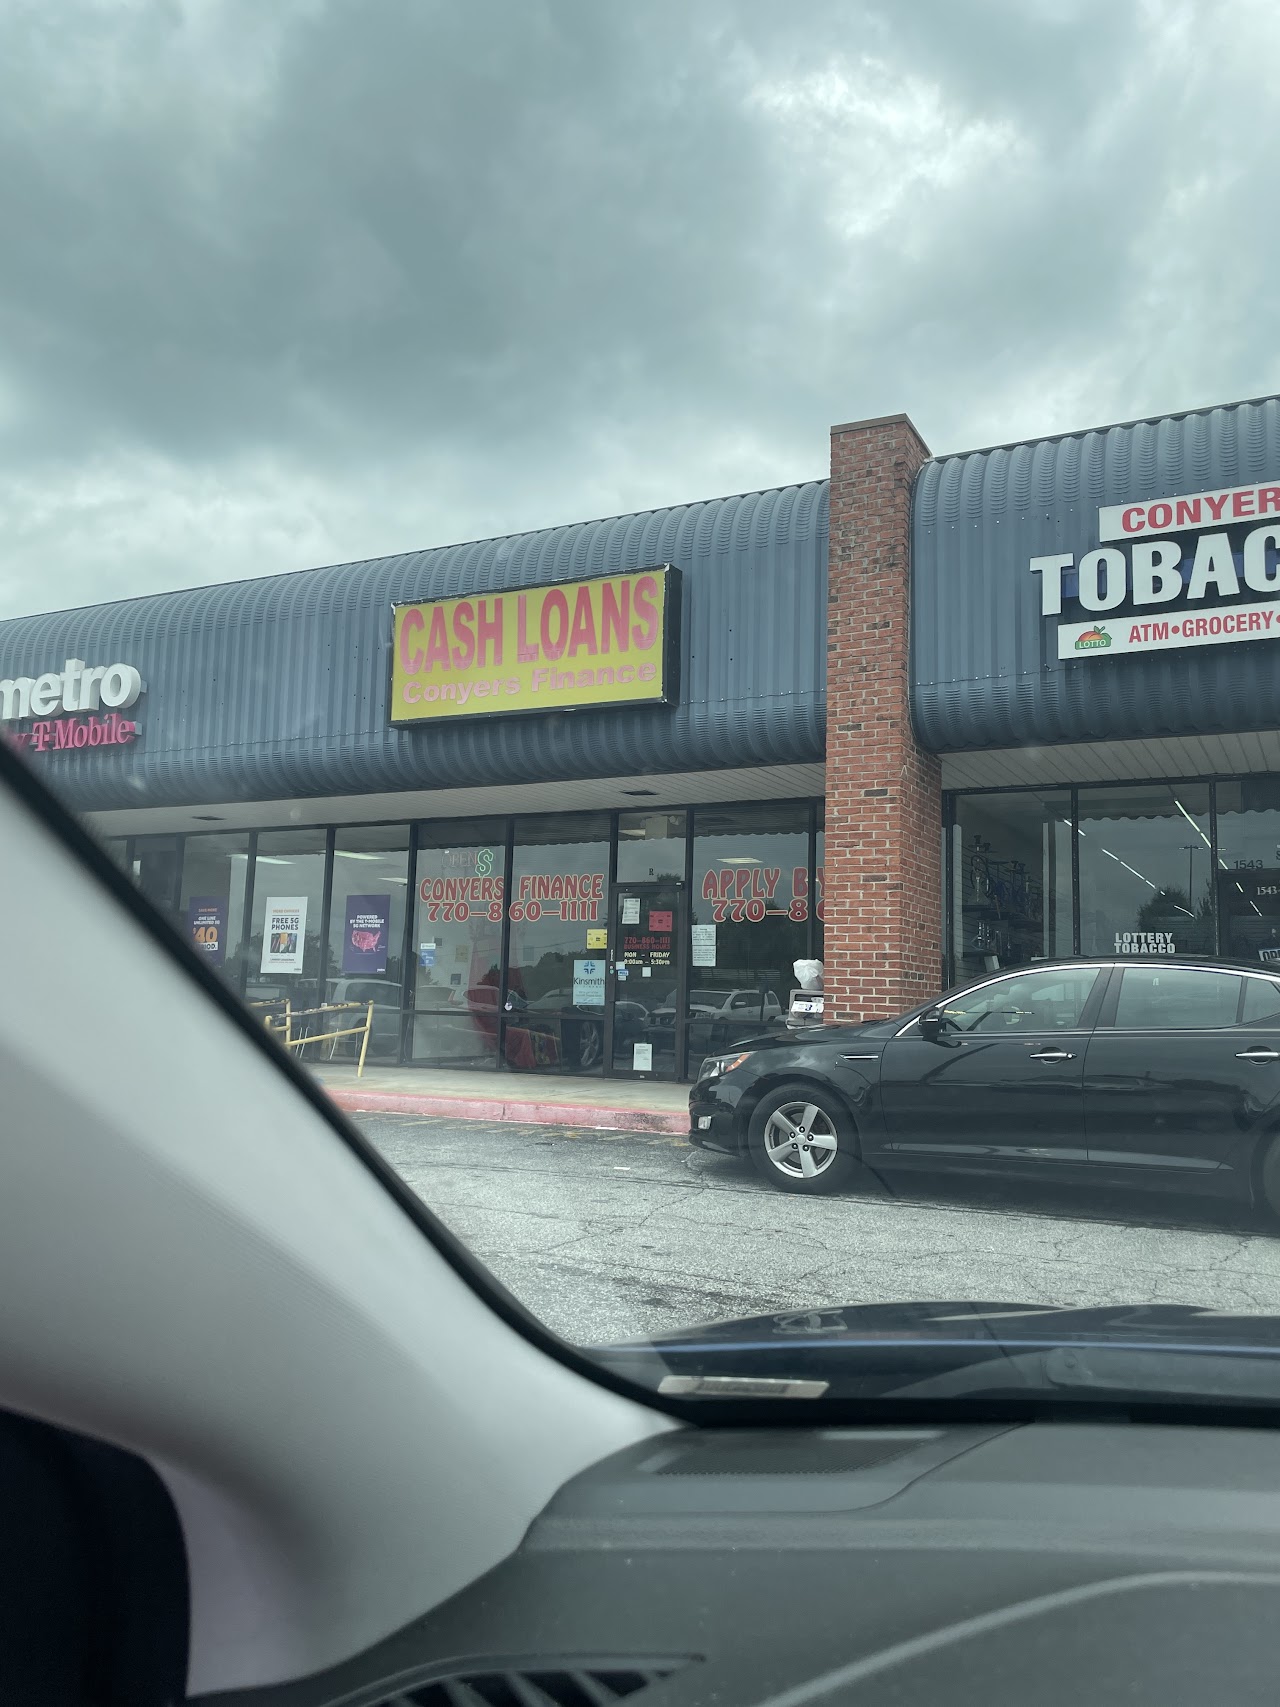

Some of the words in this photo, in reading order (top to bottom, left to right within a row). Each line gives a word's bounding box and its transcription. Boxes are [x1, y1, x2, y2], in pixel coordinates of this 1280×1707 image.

[400, 598, 503, 675] CASH
[518, 576, 658, 663] LOANS
[1079, 639, 1107, 649] LOTTO
[0, 658, 141, 719] metro
[403, 677, 520, 705] Conyers
[531, 663, 656, 691] Finance
[1234, 860, 1263, 869] 1543
[420, 876, 504, 902] CONYERS
[519, 874, 604, 900] FINANCE
[702, 868, 781, 899] APPLY
[1115, 932, 1173, 943] LOTTERY
[1114, 943, 1176, 954] TOBACCO
[573, 977, 605, 985] Kinsmith
